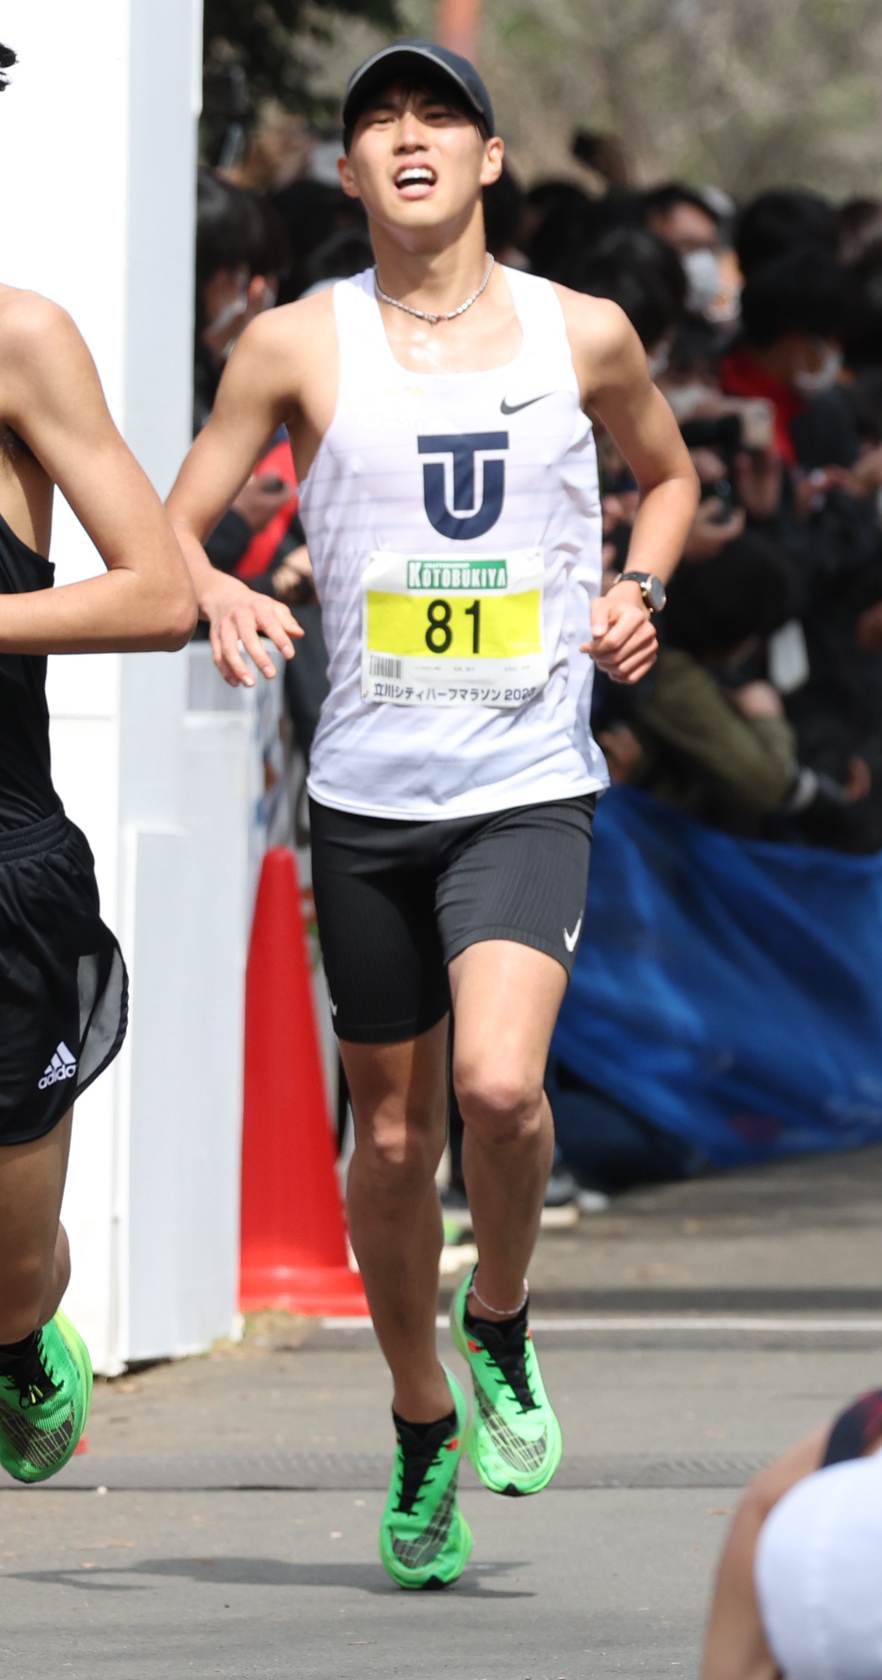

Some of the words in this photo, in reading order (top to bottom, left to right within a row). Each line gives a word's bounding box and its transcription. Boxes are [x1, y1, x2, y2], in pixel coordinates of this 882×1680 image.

[408, 561, 507, 588] KOTOBUKIYA
[425, 599, 481, 654] 81
[374, 683, 501, 701] 立川シティハーフマラソン
[38, 1064, 77, 1089] adida
